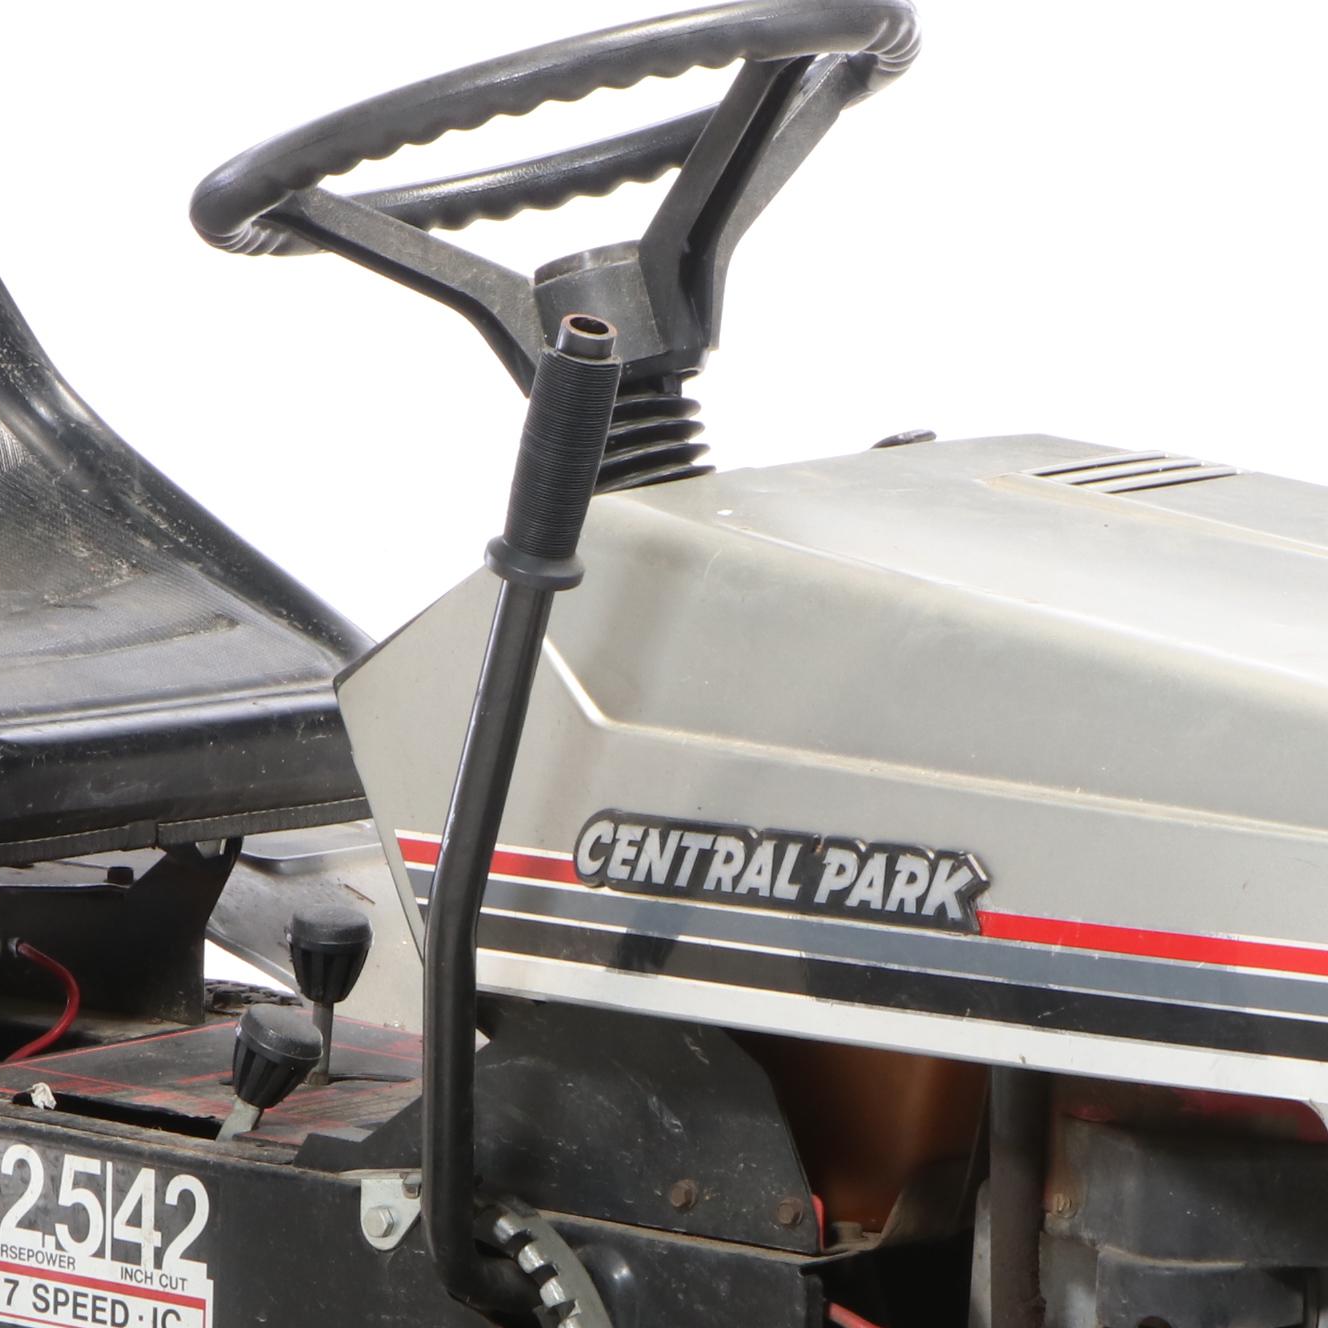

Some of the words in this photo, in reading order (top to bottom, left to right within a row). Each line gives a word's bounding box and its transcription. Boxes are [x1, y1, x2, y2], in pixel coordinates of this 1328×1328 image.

[576, 819, 802, 900] CENTRAL
[813, 847, 975, 920] PARK
[3, 1278, 20, 1306] 7
[31, 1283, 130, 1328] SPEED
[120, 1266, 154, 1286] INCH
[158, 1274, 187, 1292] CUT
